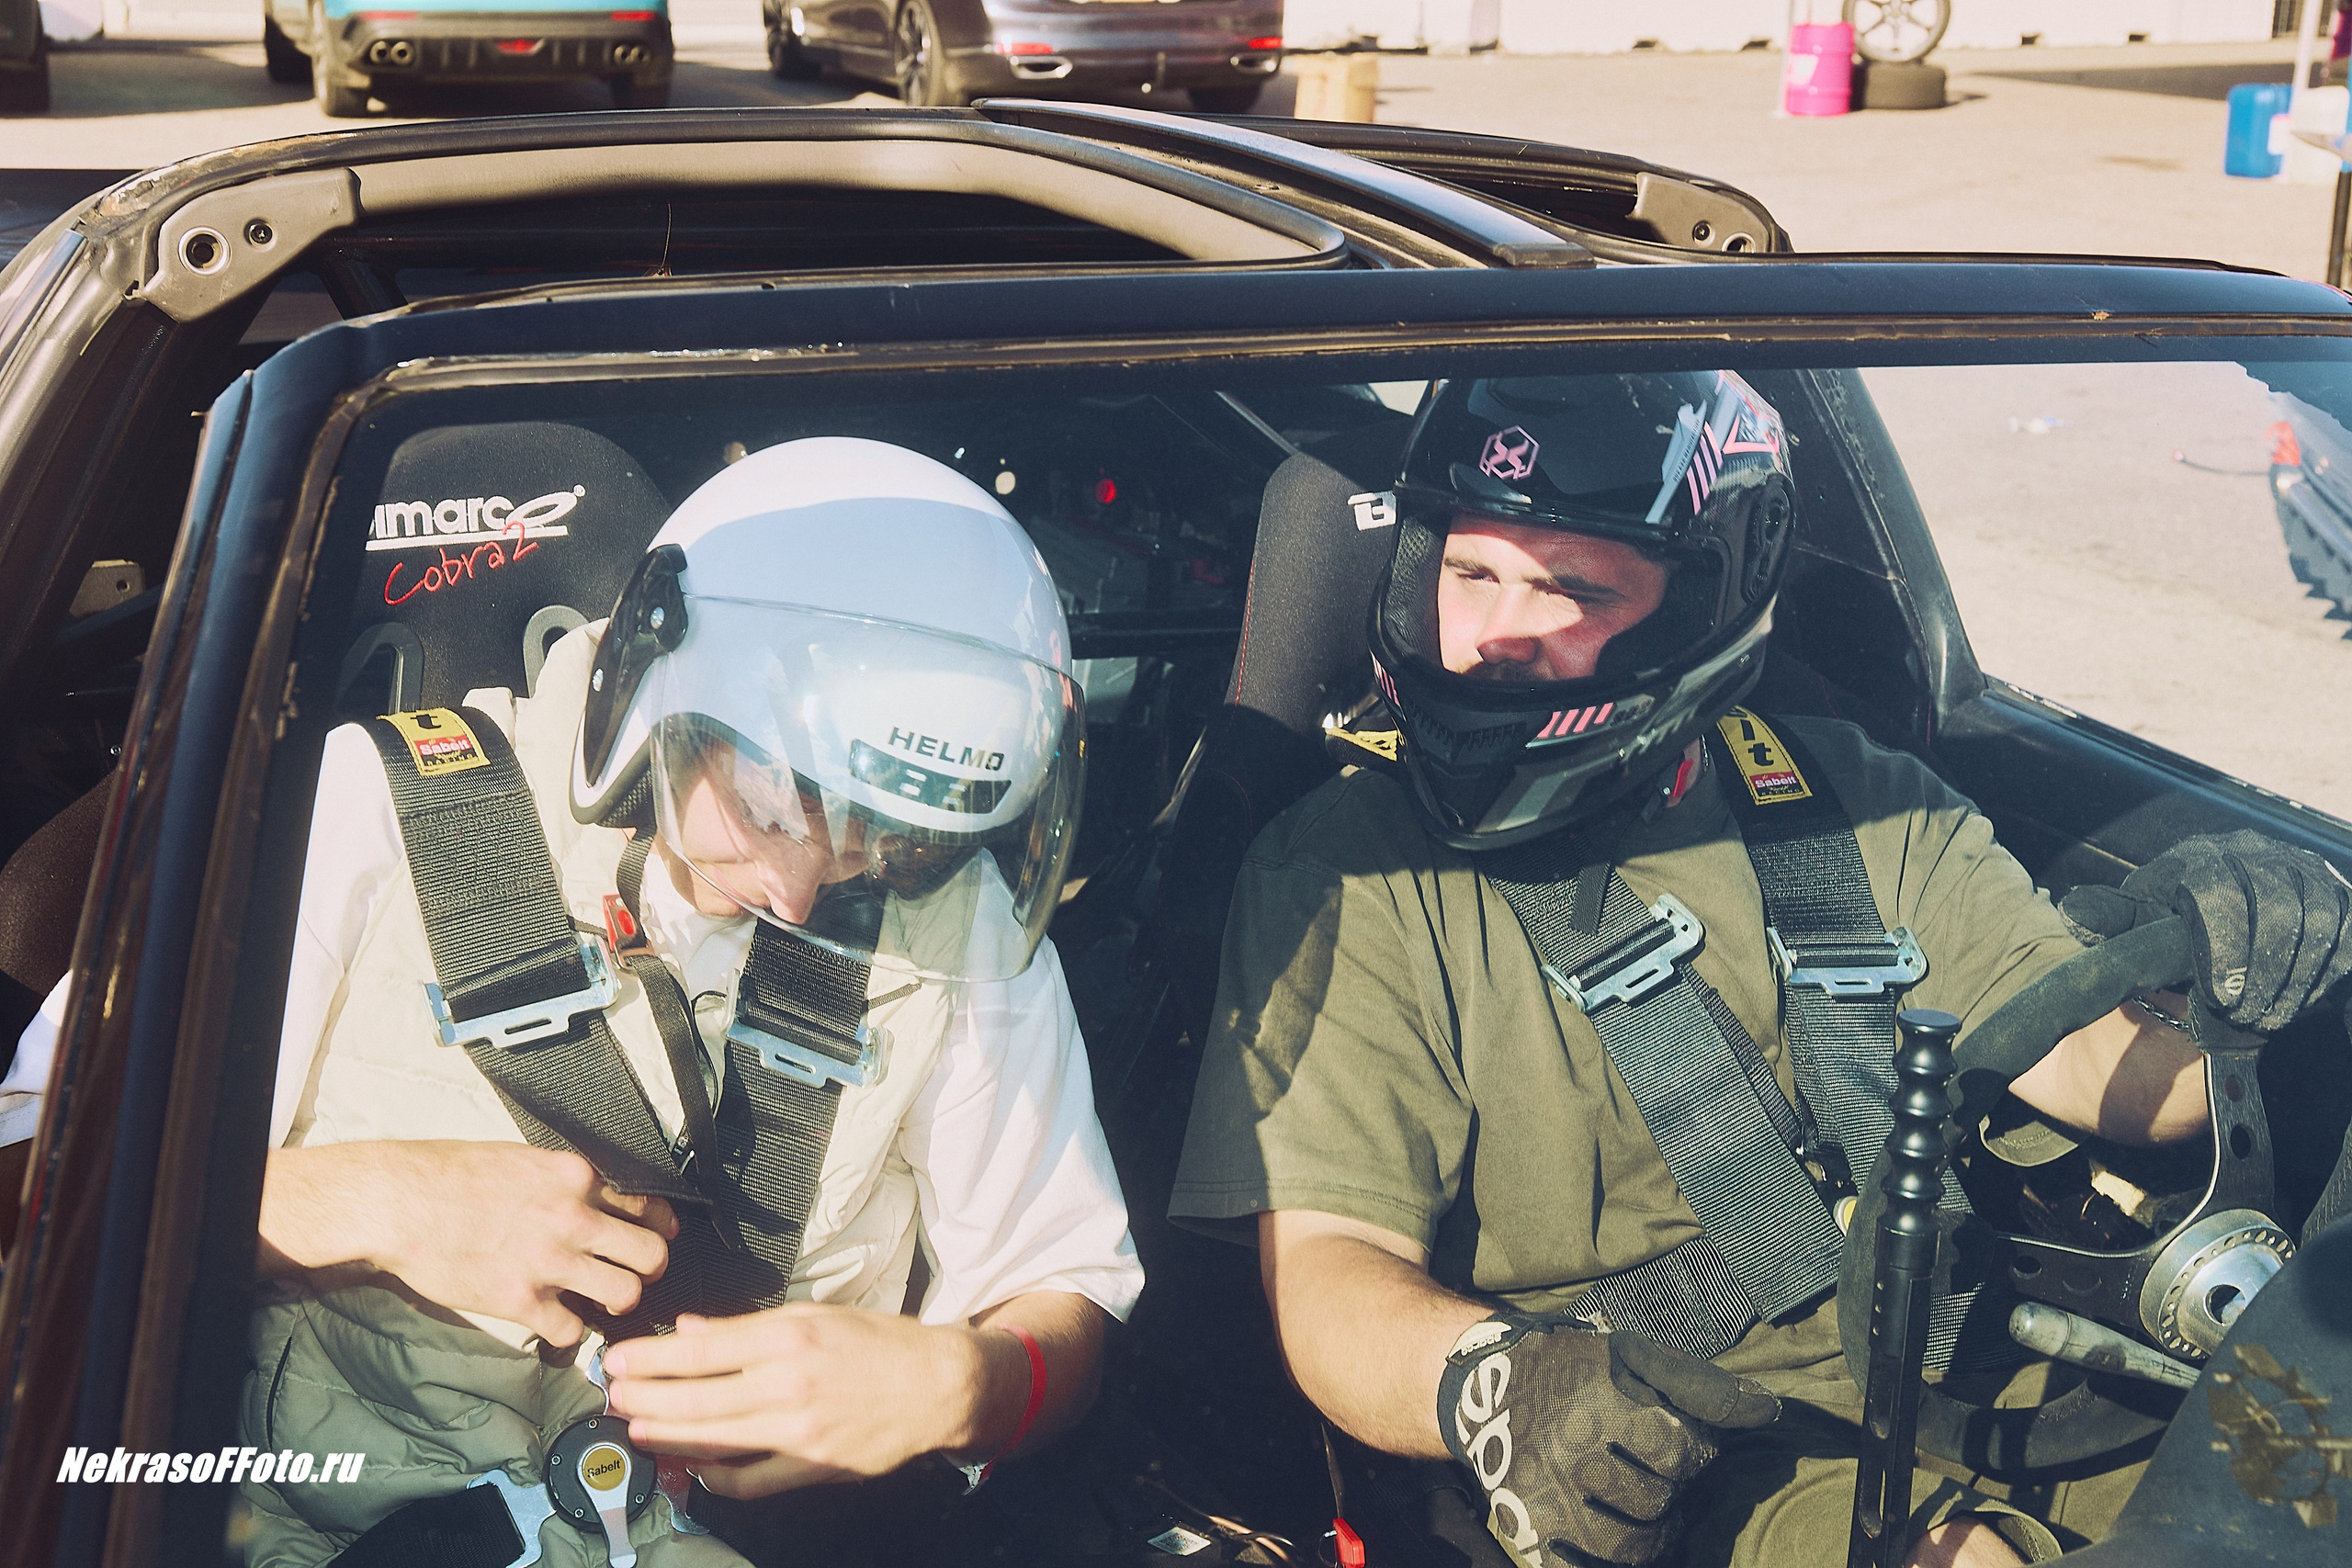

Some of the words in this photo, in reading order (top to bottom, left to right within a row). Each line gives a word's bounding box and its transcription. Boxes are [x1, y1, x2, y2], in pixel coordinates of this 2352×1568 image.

[888, 726, 1005, 772] HELMO
[1755, 776, 1796, 788] Sabelt
[587, 1459, 621, 1478] Sabelt
